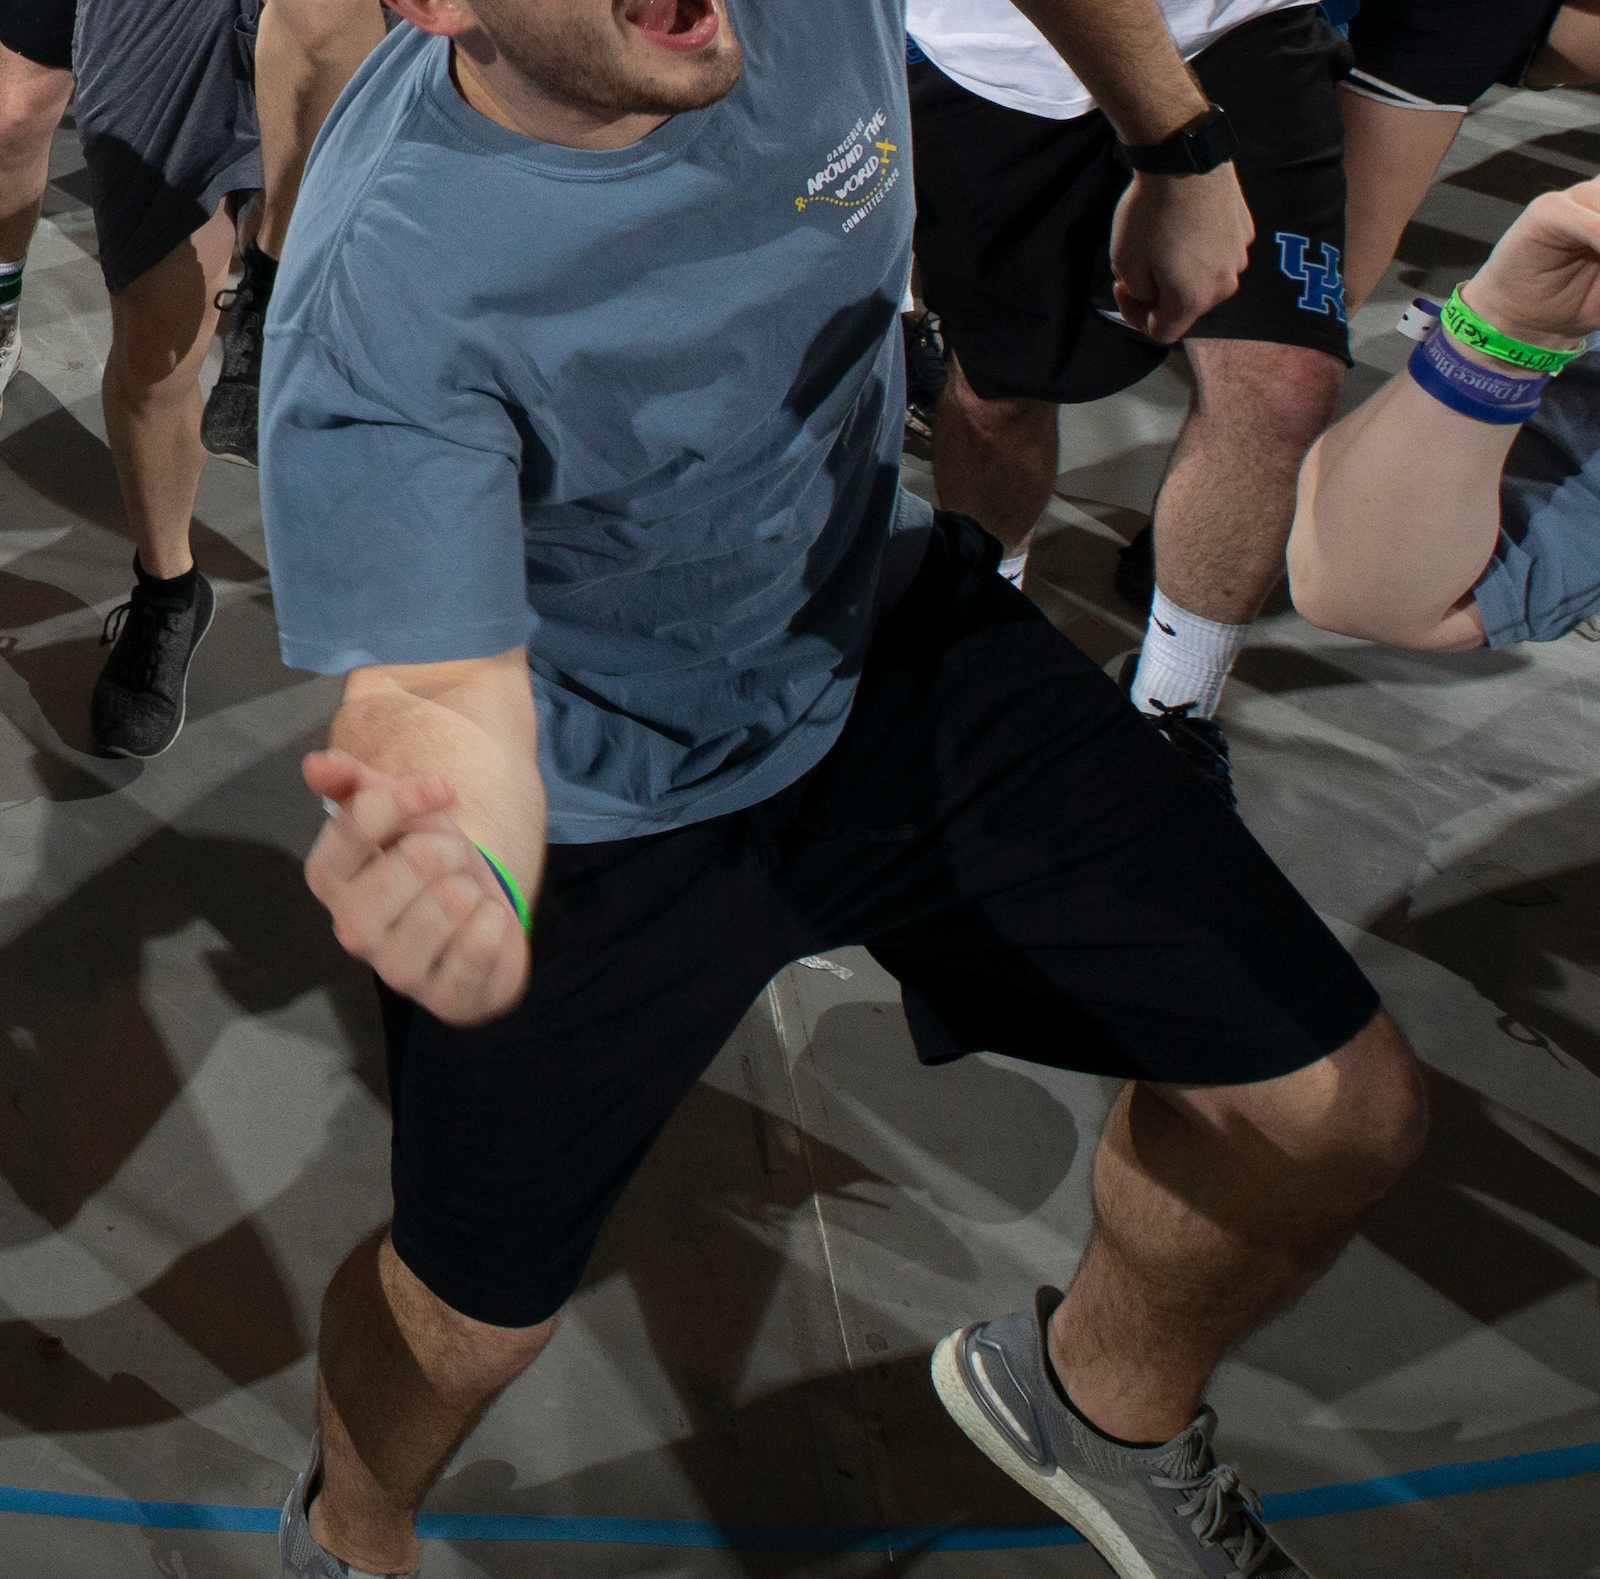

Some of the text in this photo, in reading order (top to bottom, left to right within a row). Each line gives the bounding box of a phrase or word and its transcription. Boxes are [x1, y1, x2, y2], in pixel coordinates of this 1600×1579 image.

[806, 107, 888, 196] AROUND THE
[826, 117, 866, 163] DANCEBLUE
[835, 155, 880, 200] WORLD
[841, 189, 886, 234] COMMITTEE
[1275, 232, 1347, 321] UK
